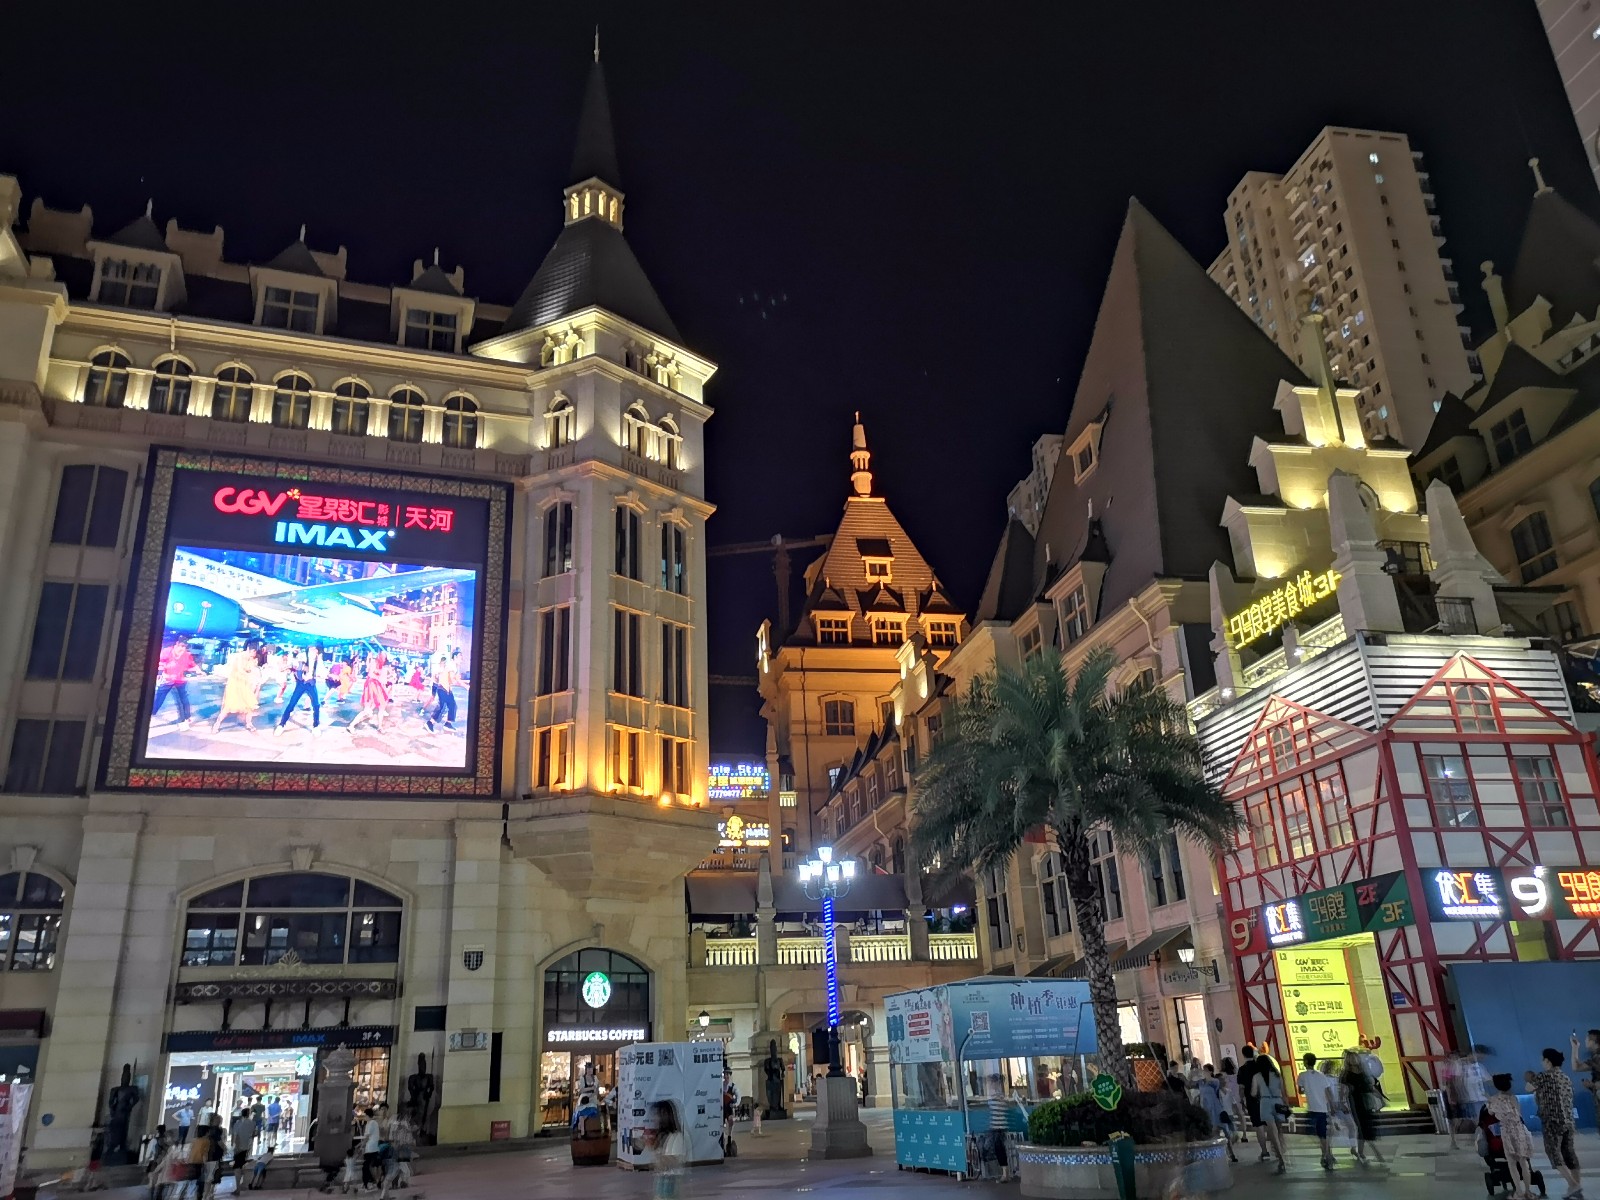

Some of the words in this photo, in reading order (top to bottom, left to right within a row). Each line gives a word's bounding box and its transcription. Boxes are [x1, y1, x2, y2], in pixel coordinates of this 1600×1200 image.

[214, 486, 287, 516] CGV
[404, 506, 454, 532] 天河
[275, 521, 388, 551] IMAX
[1356, 883, 1378, 906] 2F
[1380, 900, 1406, 923] 3F
[1284, 989, 1293, 998] L2
[547, 1030, 608, 1042] STARBUCKS
[609, 1029, 645, 1041] COFFEE
[1291, 1025, 1300, 1034] L2
[292, 1033, 326, 1043] IMAX
[362, 1031, 373, 1042] 3F
